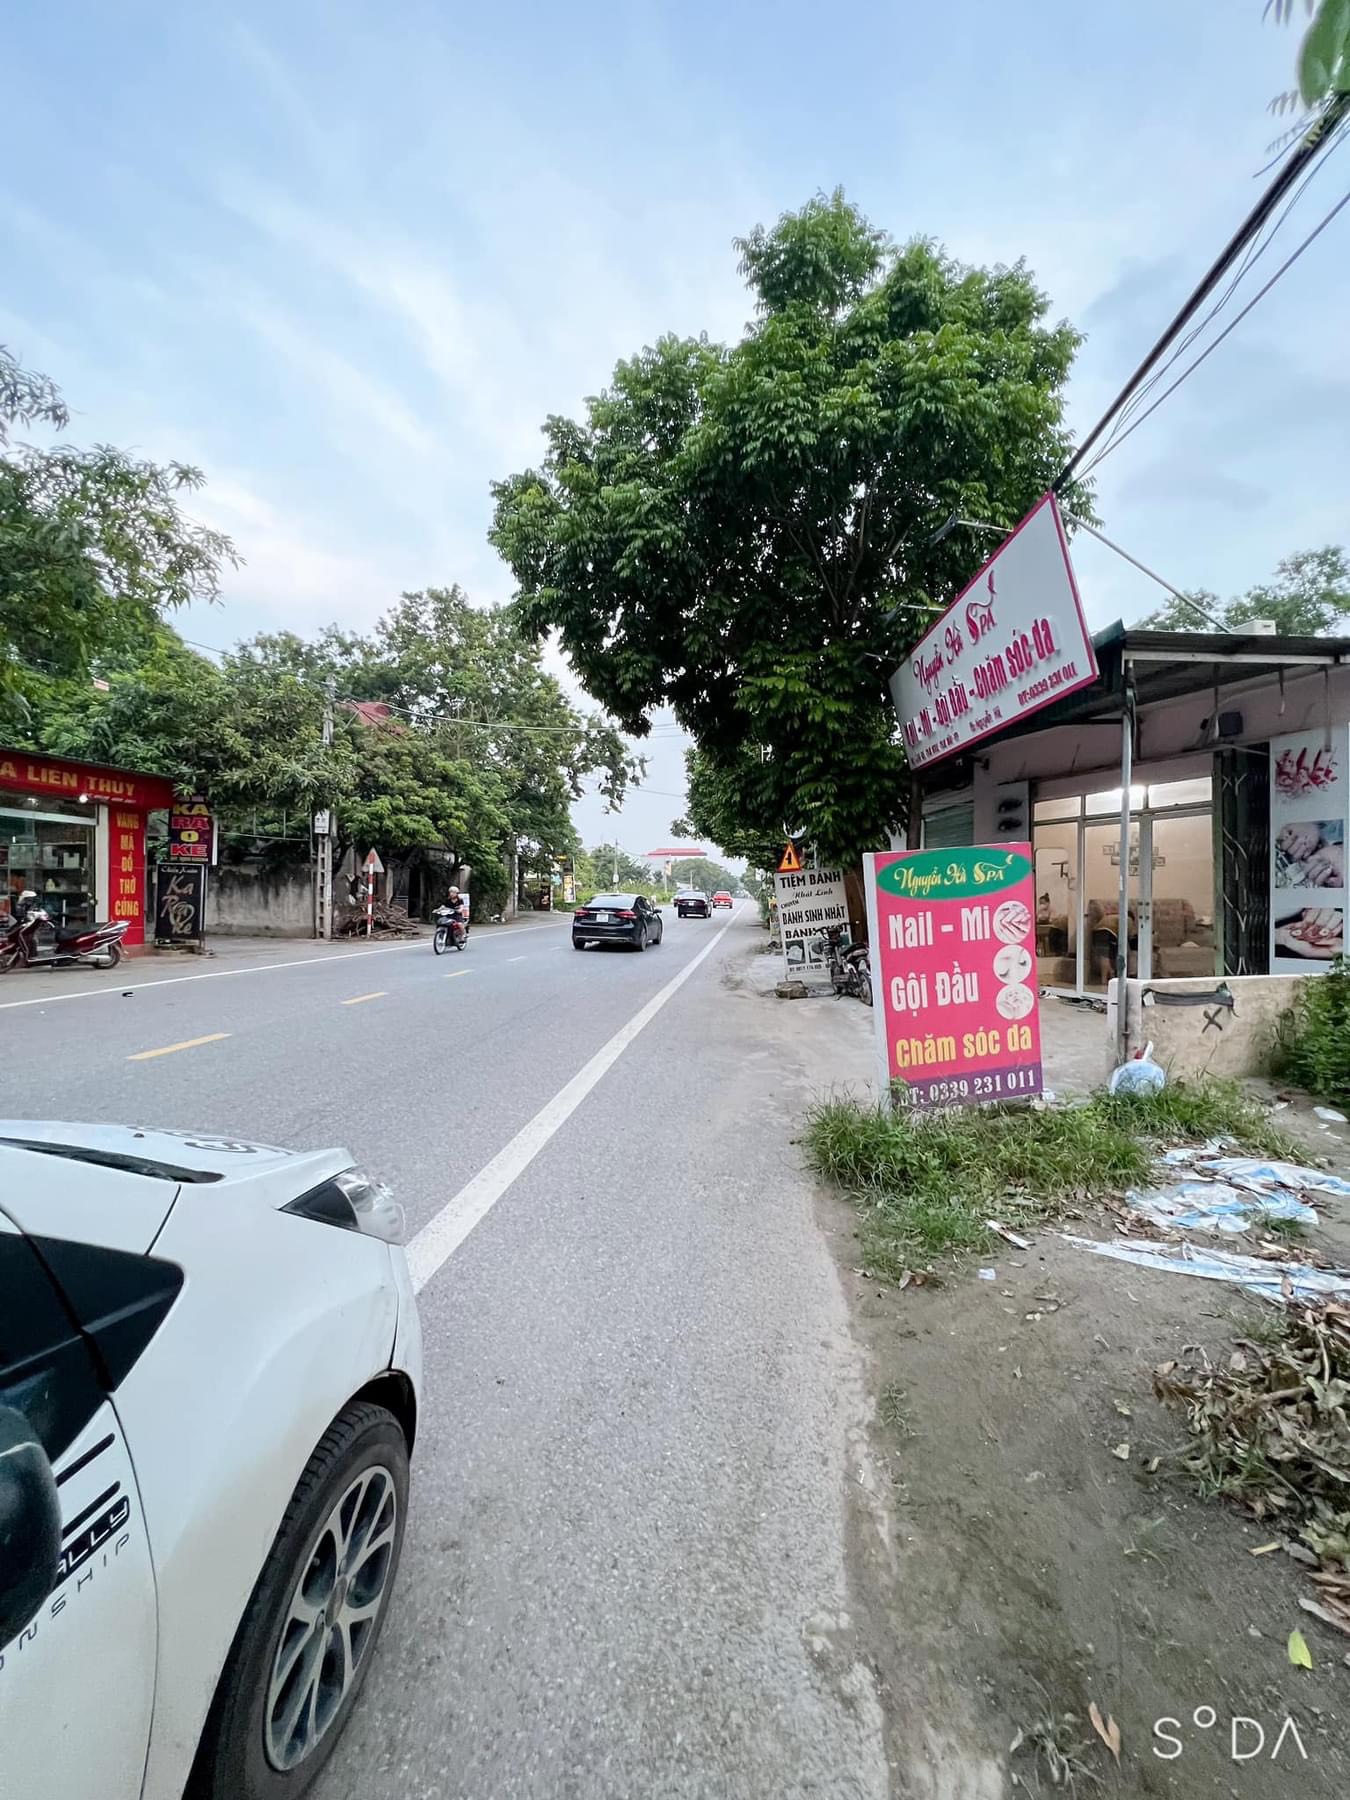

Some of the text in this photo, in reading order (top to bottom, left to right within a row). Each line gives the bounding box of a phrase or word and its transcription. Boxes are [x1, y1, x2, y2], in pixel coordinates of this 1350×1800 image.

[966, 586, 998, 645] SPA
[973, 654, 1008, 700] Chăm
[1008, 629, 1033, 678] sóc
[1032, 617, 1056, 662] da
[170, 843, 208, 857] KE
[972, 858, 1010, 886] SPA
[780, 870, 841, 890] TIỆM BÁNH
[805, 908, 824, 923] SINH
[888, 911, 934, 950] Nail
[961, 906, 991, 942] Mi
[891, 961, 979, 1018] Gội Đầu
[896, 1024, 1032, 1068] Chăm sóc da
[929, 1079, 968, 1102] 0339
[974, 1074, 1001, 1095] 231
[1007, 1069, 1035, 1089] 011
[0, 1532, 130, 1672] NSHIP
